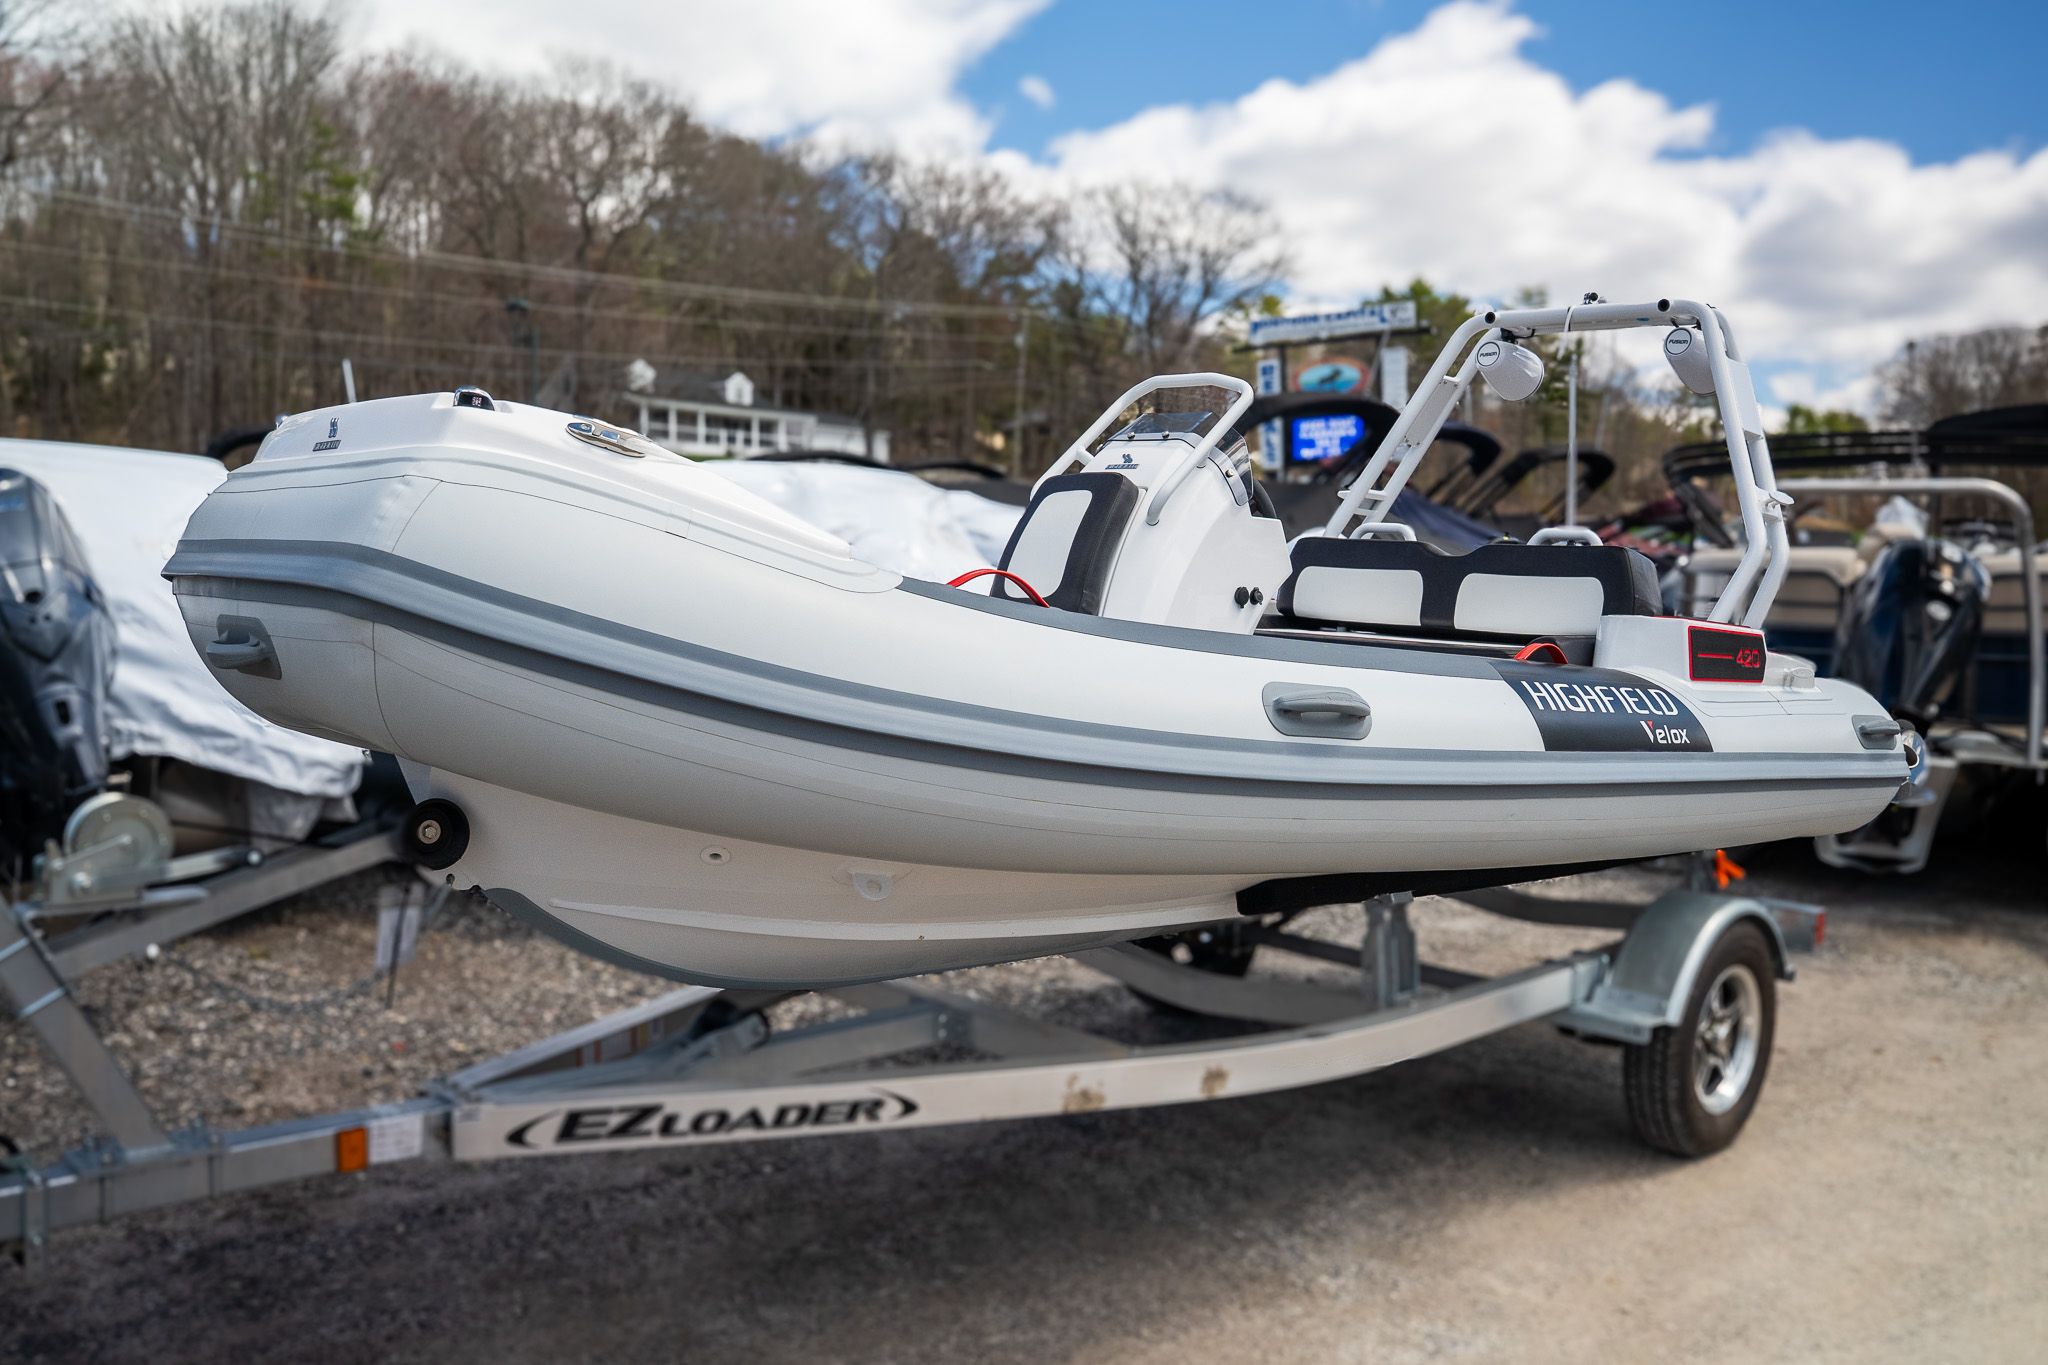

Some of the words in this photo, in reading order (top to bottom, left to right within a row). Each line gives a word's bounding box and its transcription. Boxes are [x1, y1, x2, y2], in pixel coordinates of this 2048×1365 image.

[1736, 649, 1760, 668] 420
[1521, 681, 1679, 716] HIGHFIELD
[1640, 720, 1691, 744] Velox
